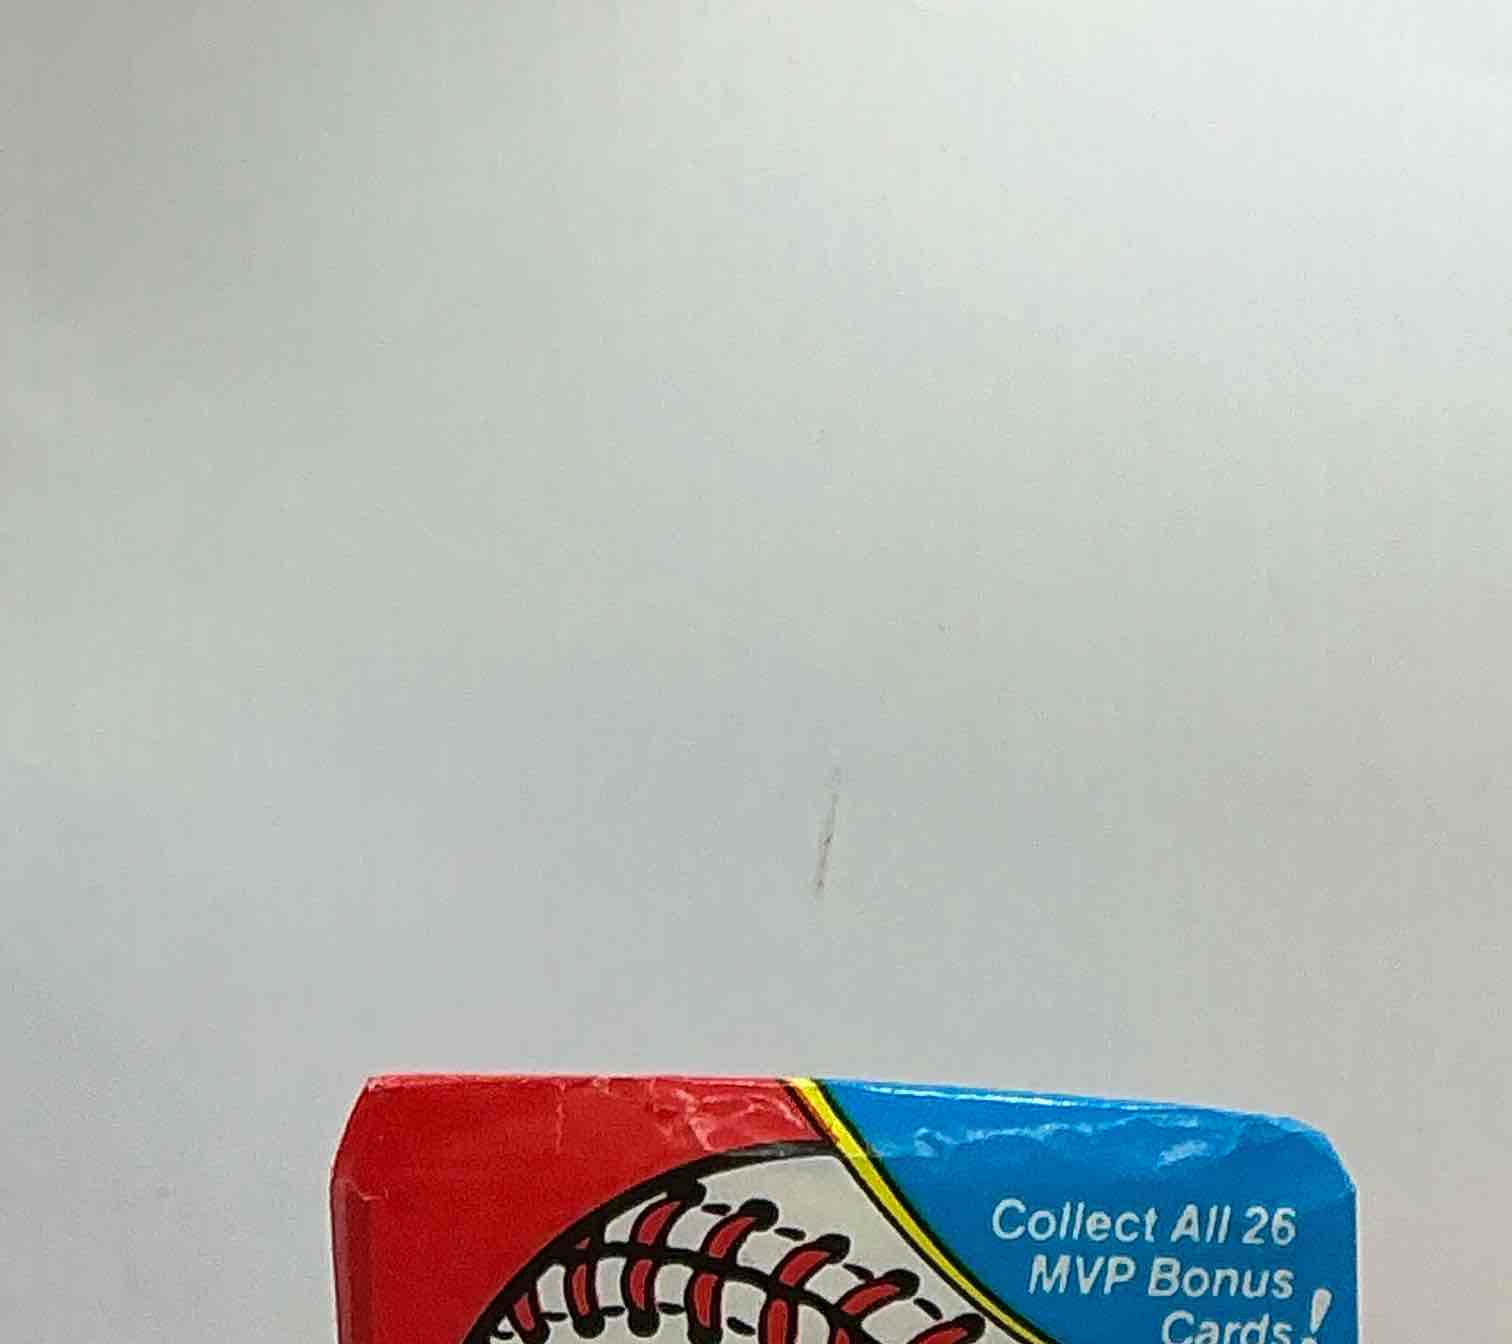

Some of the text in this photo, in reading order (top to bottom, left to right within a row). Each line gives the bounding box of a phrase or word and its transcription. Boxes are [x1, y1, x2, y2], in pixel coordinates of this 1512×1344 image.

[991, 1198, 1297, 1246] Collect All 26
[1028, 1254, 1295, 1299] MVP Bonus
